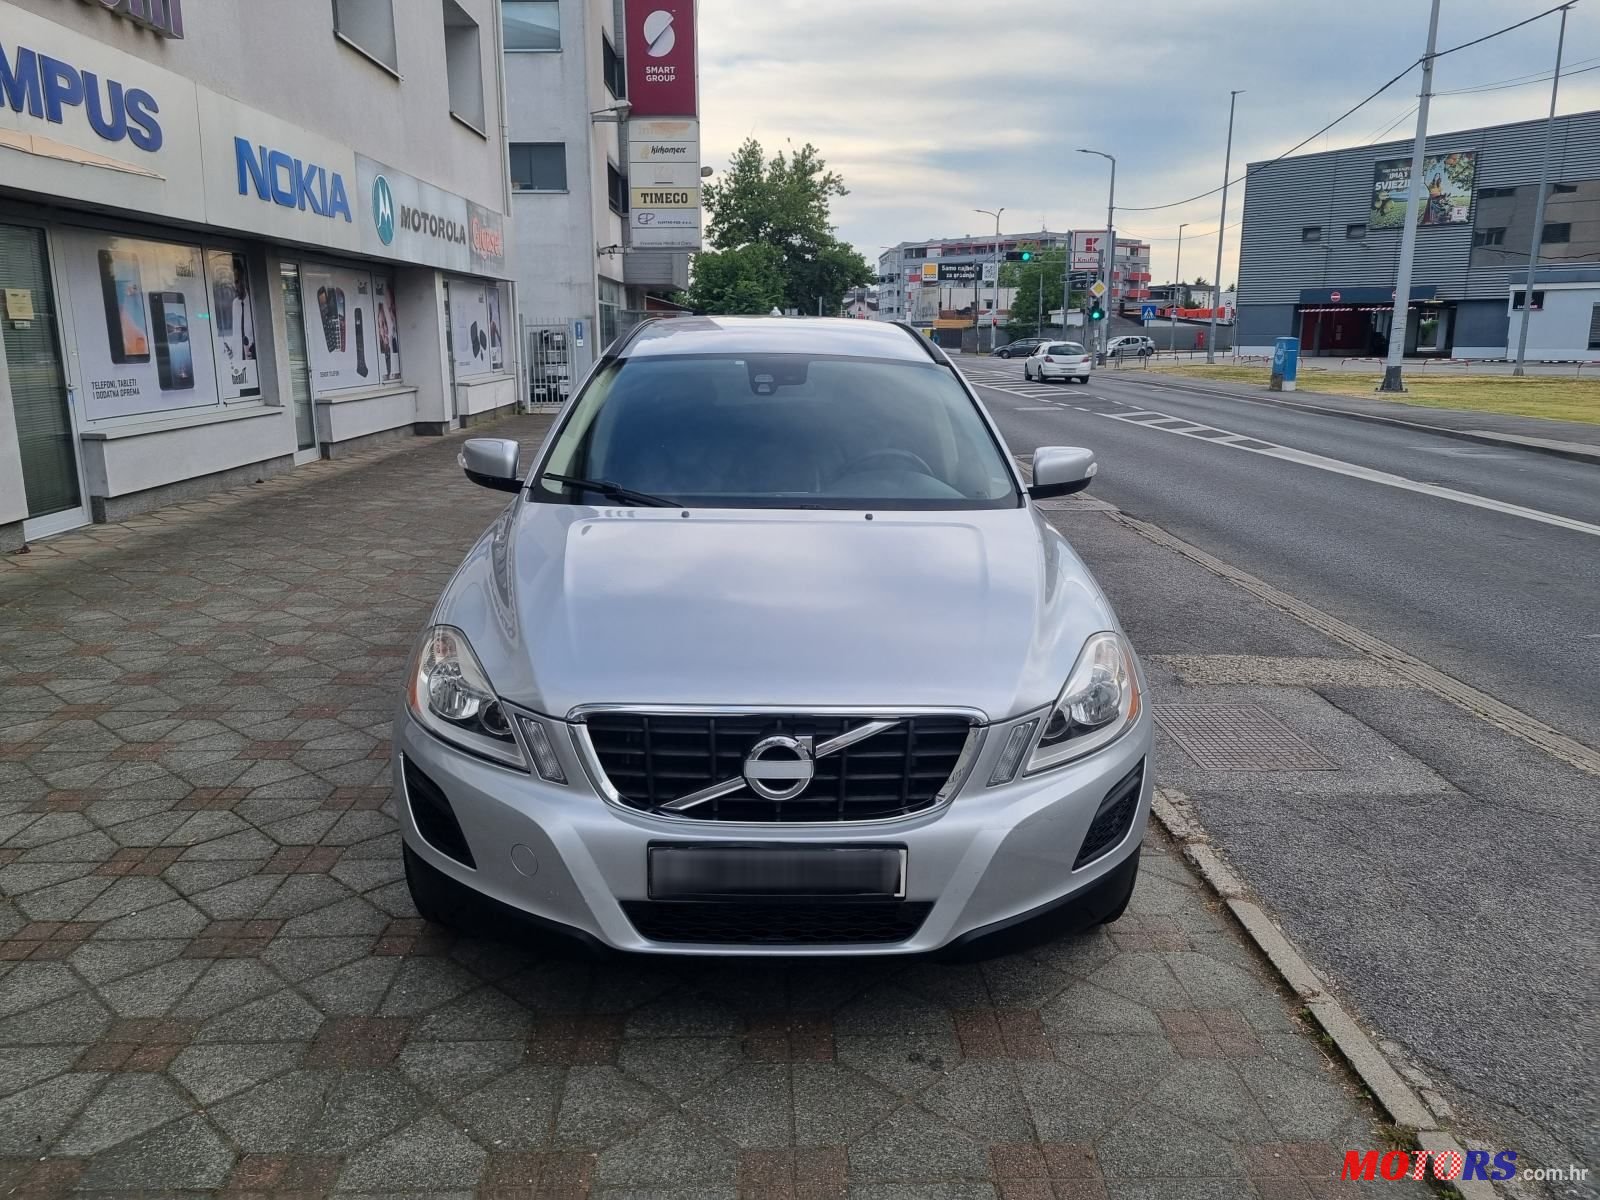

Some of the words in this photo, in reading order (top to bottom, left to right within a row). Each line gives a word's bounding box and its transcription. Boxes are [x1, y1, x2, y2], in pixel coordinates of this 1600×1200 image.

[646, 66, 675, 74] SMART
[646, 74, 675, 82] GROUP
[234, 136, 352, 223] NOKIA
[640, 192, 688, 204] TIMECO
[400, 205, 466, 245] MOTOROLA
[91, 380, 117, 390] TELEFONI,
[117, 378, 137, 388] TABLETI
[96, 389, 119, 400] DODATNA
[120, 387, 140, 397] OPREMA
